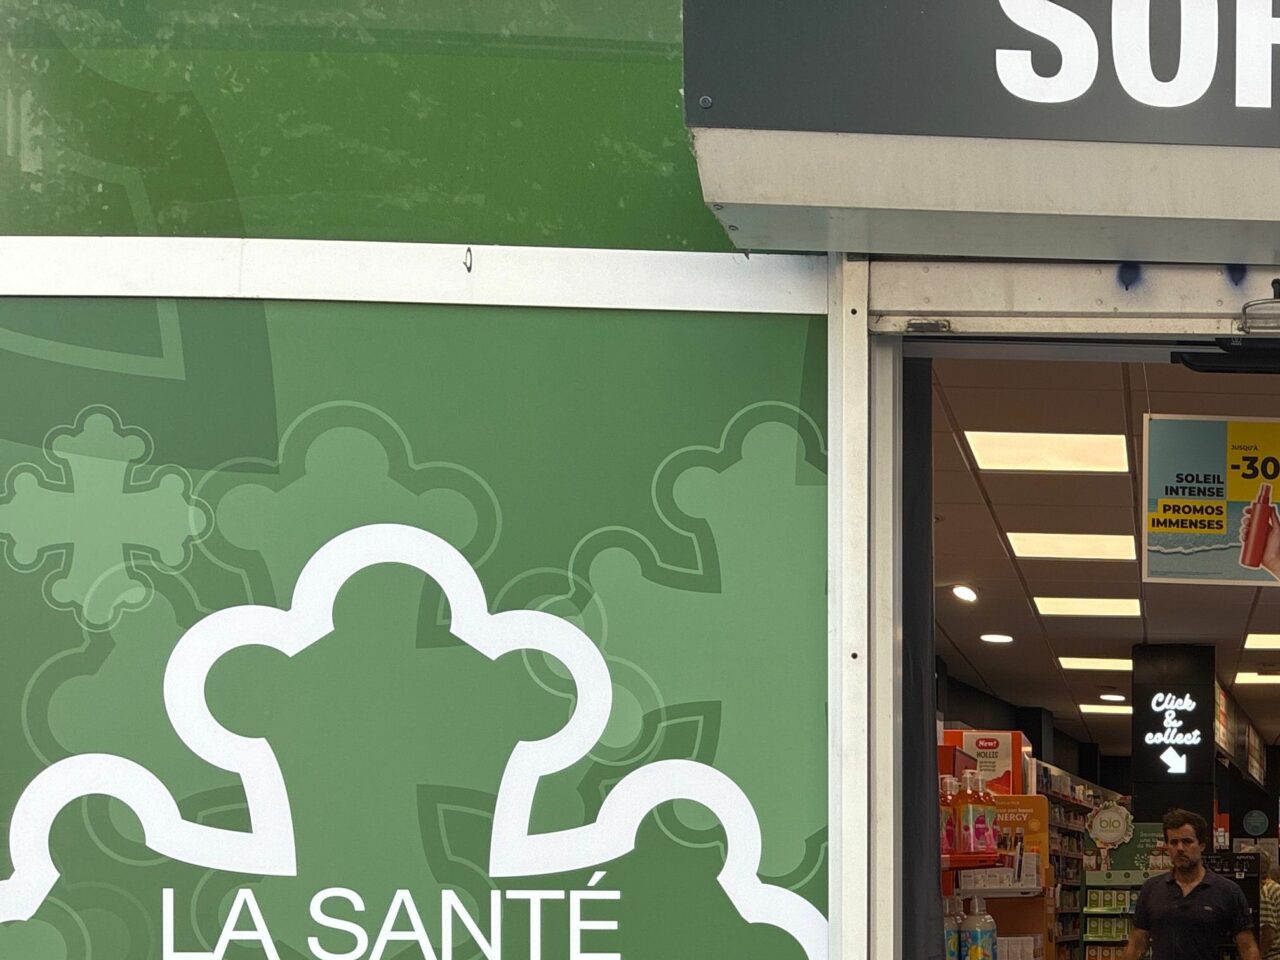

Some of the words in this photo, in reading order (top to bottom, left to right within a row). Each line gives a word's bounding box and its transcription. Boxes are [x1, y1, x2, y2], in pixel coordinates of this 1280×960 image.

[1175, 473, 1225, 485] SOLEIL
[1164, 485, 1225, 498] INTENSE
[1162, 504, 1224, 516] PROMOS
[1151, 518, 1224, 530] IMMENSES
[1151, 692, 1197, 712] Click
[1163, 710, 1184, 728] &
[1144, 727, 1202, 745] collect
[997, 813, 1028, 821] NERGY
